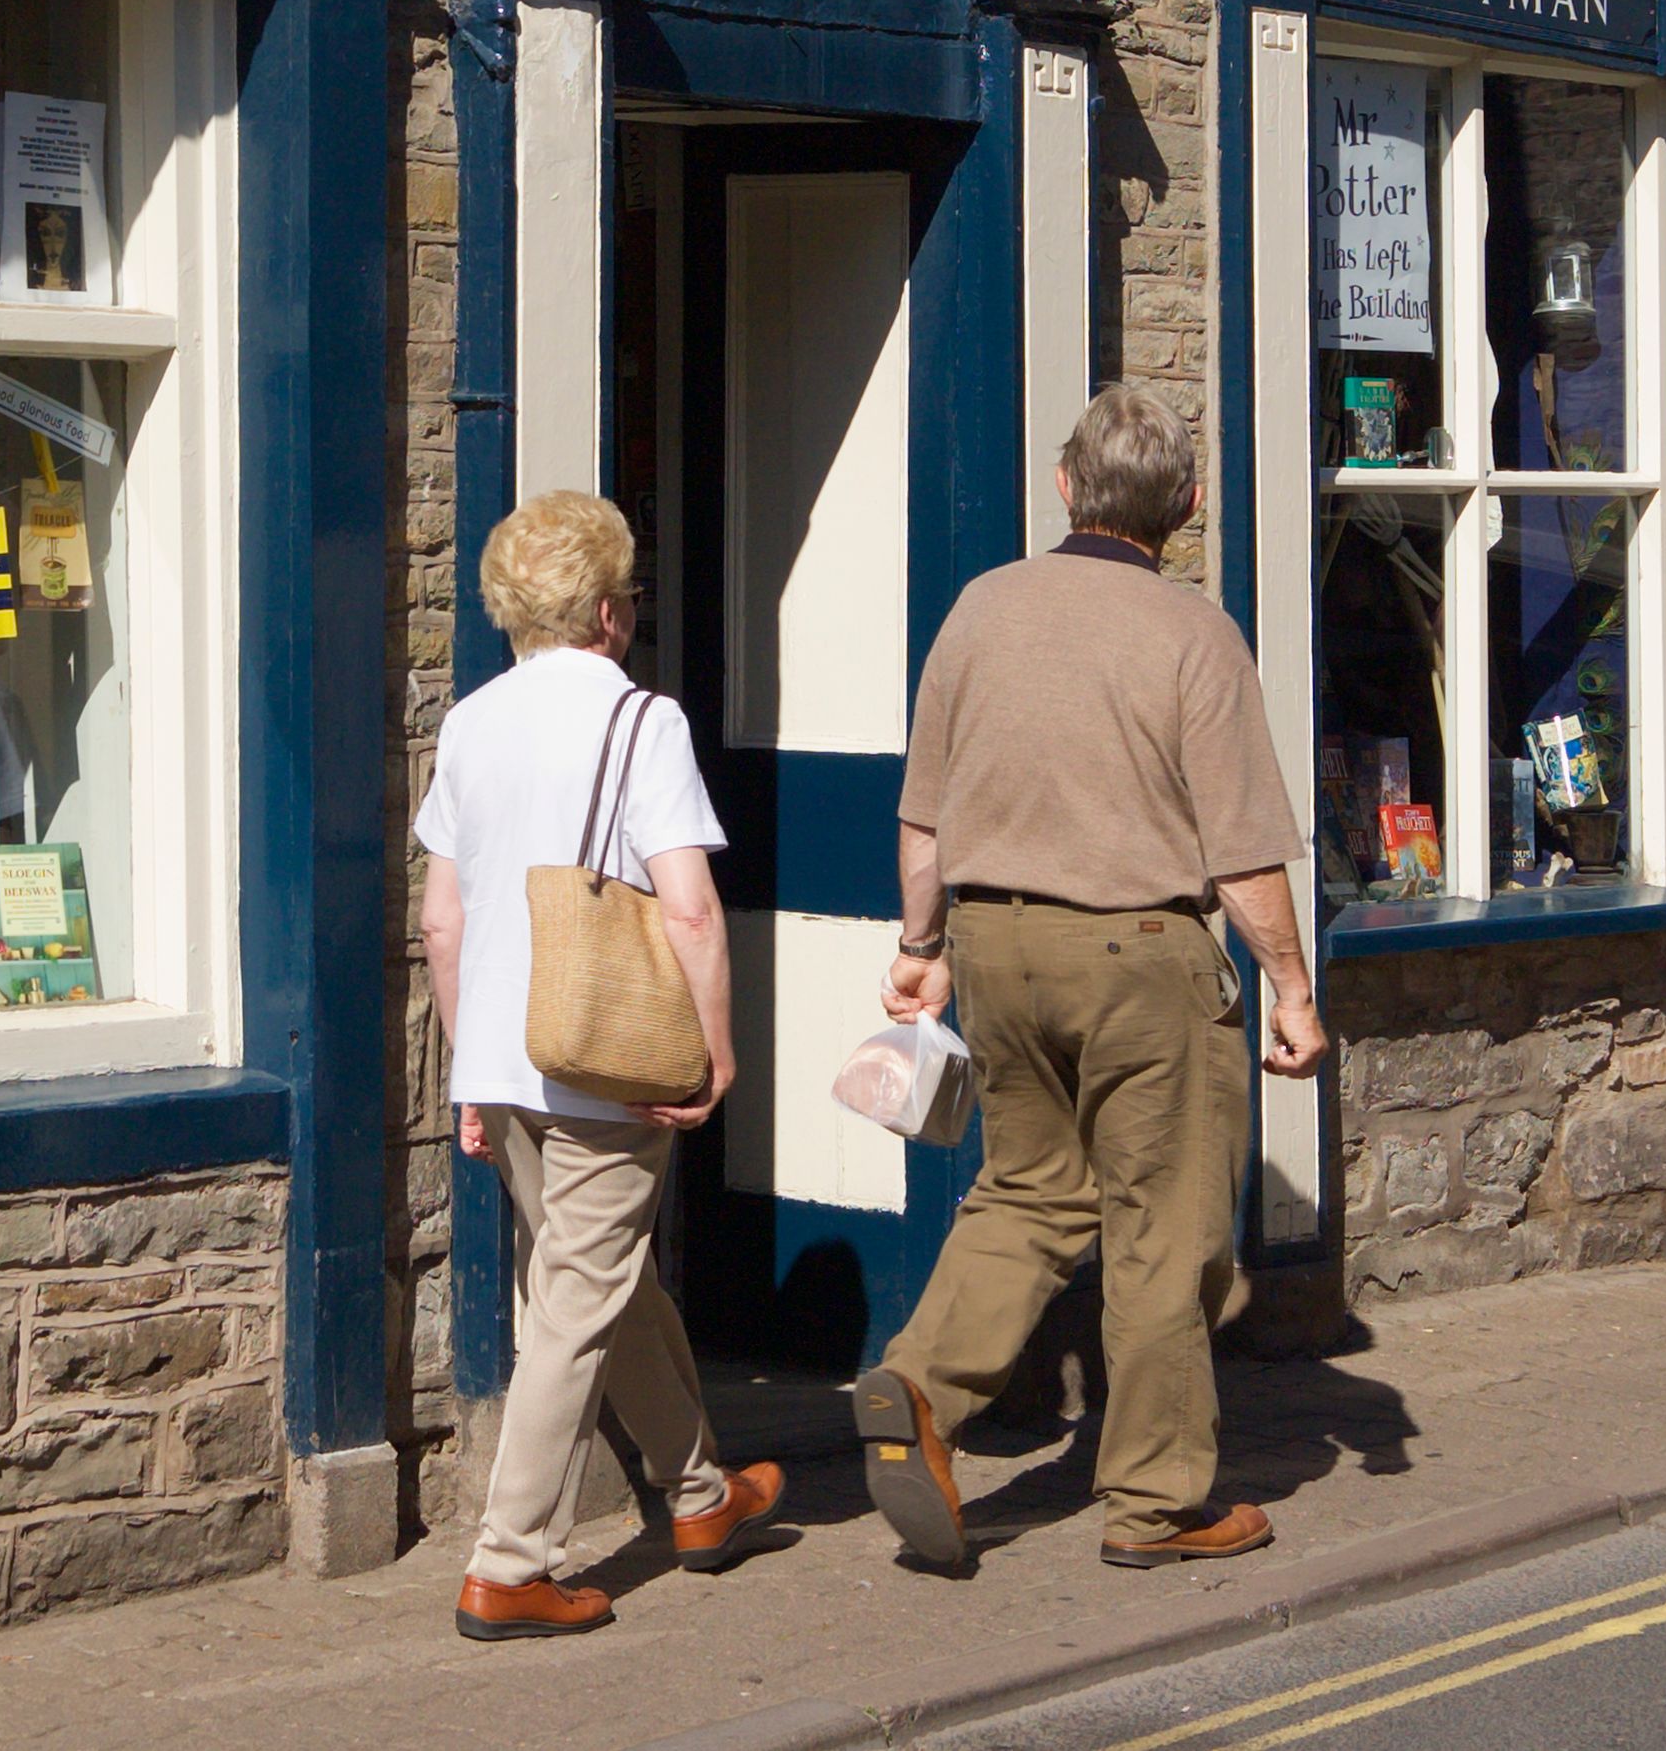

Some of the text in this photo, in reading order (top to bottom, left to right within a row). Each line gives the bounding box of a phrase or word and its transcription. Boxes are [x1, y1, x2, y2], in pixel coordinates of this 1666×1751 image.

[1331, 96, 1379, 149] Mr
[1321, 237, 1412, 282] Has Left
[1317, 289, 1343, 323] he
[18, 397, 63, 430] glorious
[64, 420, 91, 444] food
[2, 868, 55, 879] SLOE GIN
[4, 886, 58, 897] BEESWAX
